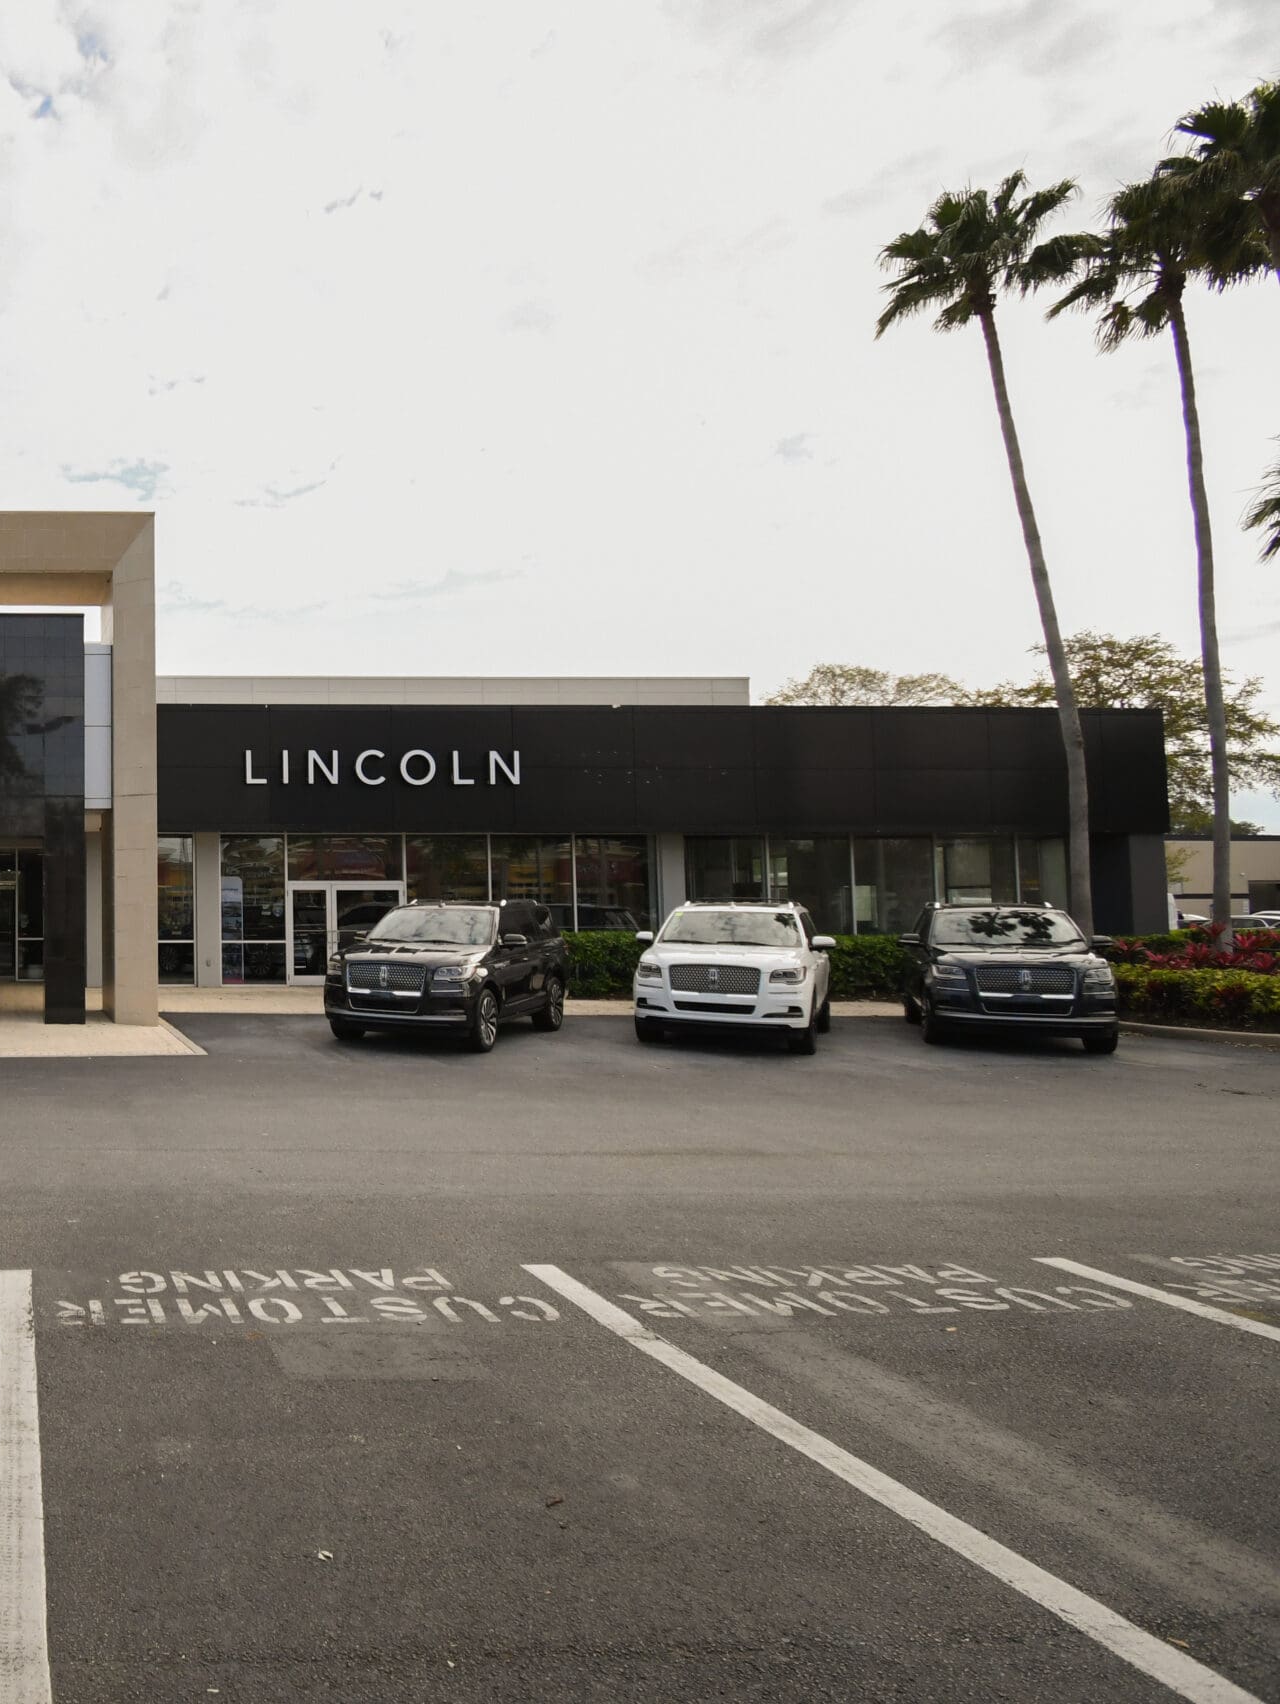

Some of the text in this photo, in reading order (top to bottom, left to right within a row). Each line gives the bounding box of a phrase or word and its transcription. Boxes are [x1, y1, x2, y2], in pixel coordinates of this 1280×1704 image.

[245, 749, 520, 786] LINCOLN
[119, 1269, 454, 1293] PARKING
[56, 1296, 561, 1326] CUSTOMER
